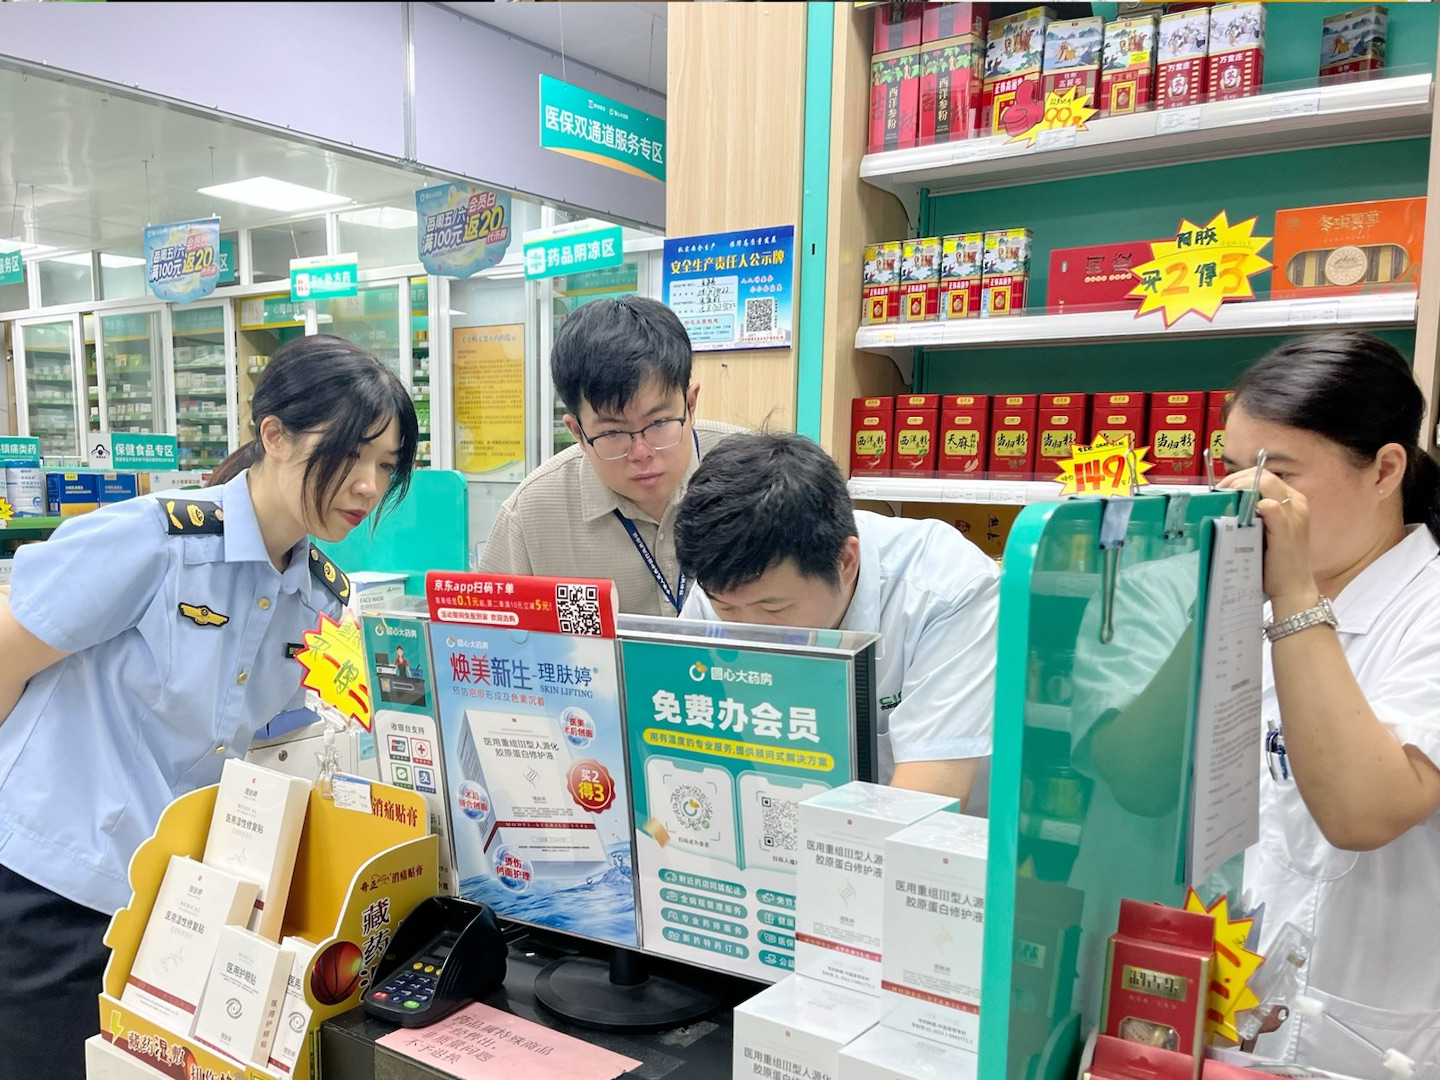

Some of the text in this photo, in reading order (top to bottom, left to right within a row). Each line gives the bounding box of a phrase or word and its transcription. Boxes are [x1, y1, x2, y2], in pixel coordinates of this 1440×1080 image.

[888, 86, 898, 130] 西洋参粉
[938, 76, 949, 121] 西洋参粉
[545, 104, 664, 164] 医保双通道服务专区
[468, 191, 497, 214] 会员日
[421, 205, 504, 255] 满100元 返20
[425, 207, 467, 232] 每周五/六
[183, 246, 214, 274] 返20
[547, 238, 616, 267] 药品阴凉区
[670, 249, 785, 275] 安全生产责任人公示牌
[115, 443, 174, 457] 保健食品专区
[947, 433, 971, 450] 天麻
[997, 433, 1028, 450] 当归粉
[1157, 433, 1196, 450] 当归粉
[1074, 454, 1125, 493] 149
[434, 579, 514, 595] 京东app扫码下单
[386, 627, 417, 638] 圆心大药房
[457, 639, 489, 650] 圆心大药房
[710, 666, 773, 686] 圆心大药房
[452, 685, 545, 708] 预防疤痕形成及色素沉着
[540, 684, 594, 699] SKIN LIFTING
[569, 717, 585, 727] 医美
[651, 689, 821, 744] 免费办会员
[390, 722, 425, 736] 收银台支持
[495, 748, 554, 761] 胶原蛋白修护液
[580, 770, 600, 784] 买2
[578, 781, 605, 802] 得3
[372, 795, 418, 828] 消痛贴膏
[225, 812, 264, 834] 医用湿性修复贴
[495, 865, 531, 882] 创面护理
[504, 856, 522, 869] 烫伤
[815, 854, 884, 879] 胶原蛋白修护液
[391, 865, 424, 884] 消痛贴膏
[678, 874, 742, 895] 附近药店同城配送
[680, 894, 742, 916] 全病程管理服务
[776, 895, 796, 908] 免费
[905, 895, 985, 924] 胶原蛋白修护液
[165, 910, 205, 935] 医用湿性修复贴
[681, 914, 743, 936] 专业药师服务
[682, 934, 744, 957] 新药特药订购
[226, 961, 258, 987] 医用护眼贴
[127, 1030, 187, 1068] 藏药湿敷
[404, 1036, 463, 1065] 不予退换
[421, 1030, 497, 1063] 非质量问题
